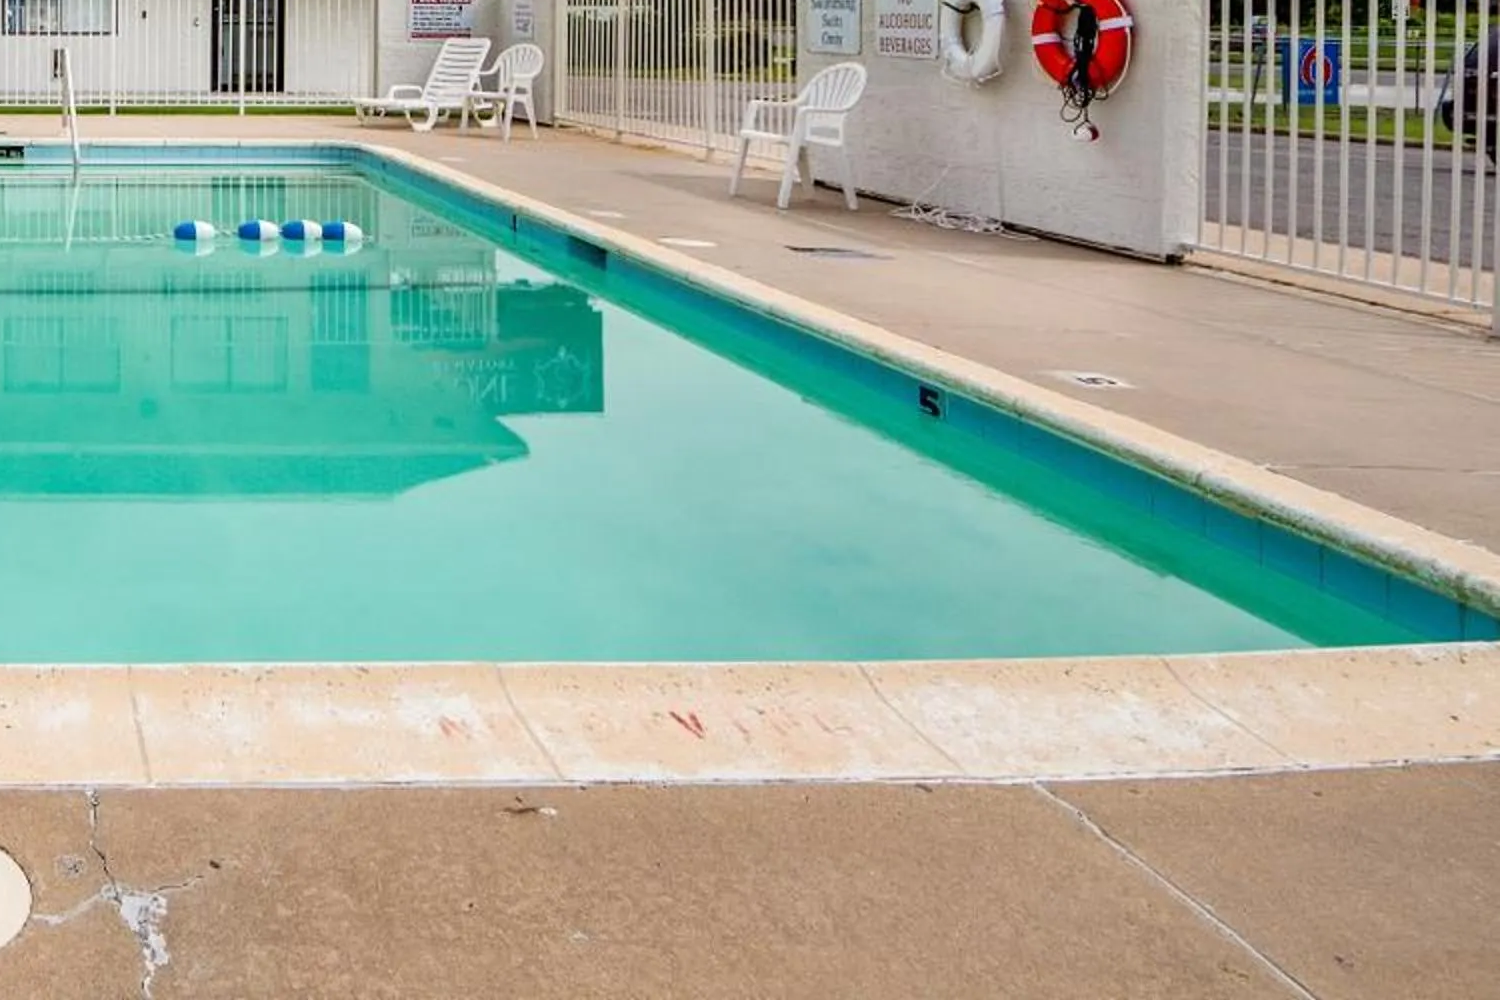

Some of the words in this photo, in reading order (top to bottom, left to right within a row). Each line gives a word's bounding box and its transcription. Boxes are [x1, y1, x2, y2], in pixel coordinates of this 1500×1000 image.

[879, 12, 934, 31] ALCOHOLIC
[879, 36, 933, 56] BEVERAGES
[919, 385, 942, 416] 5
